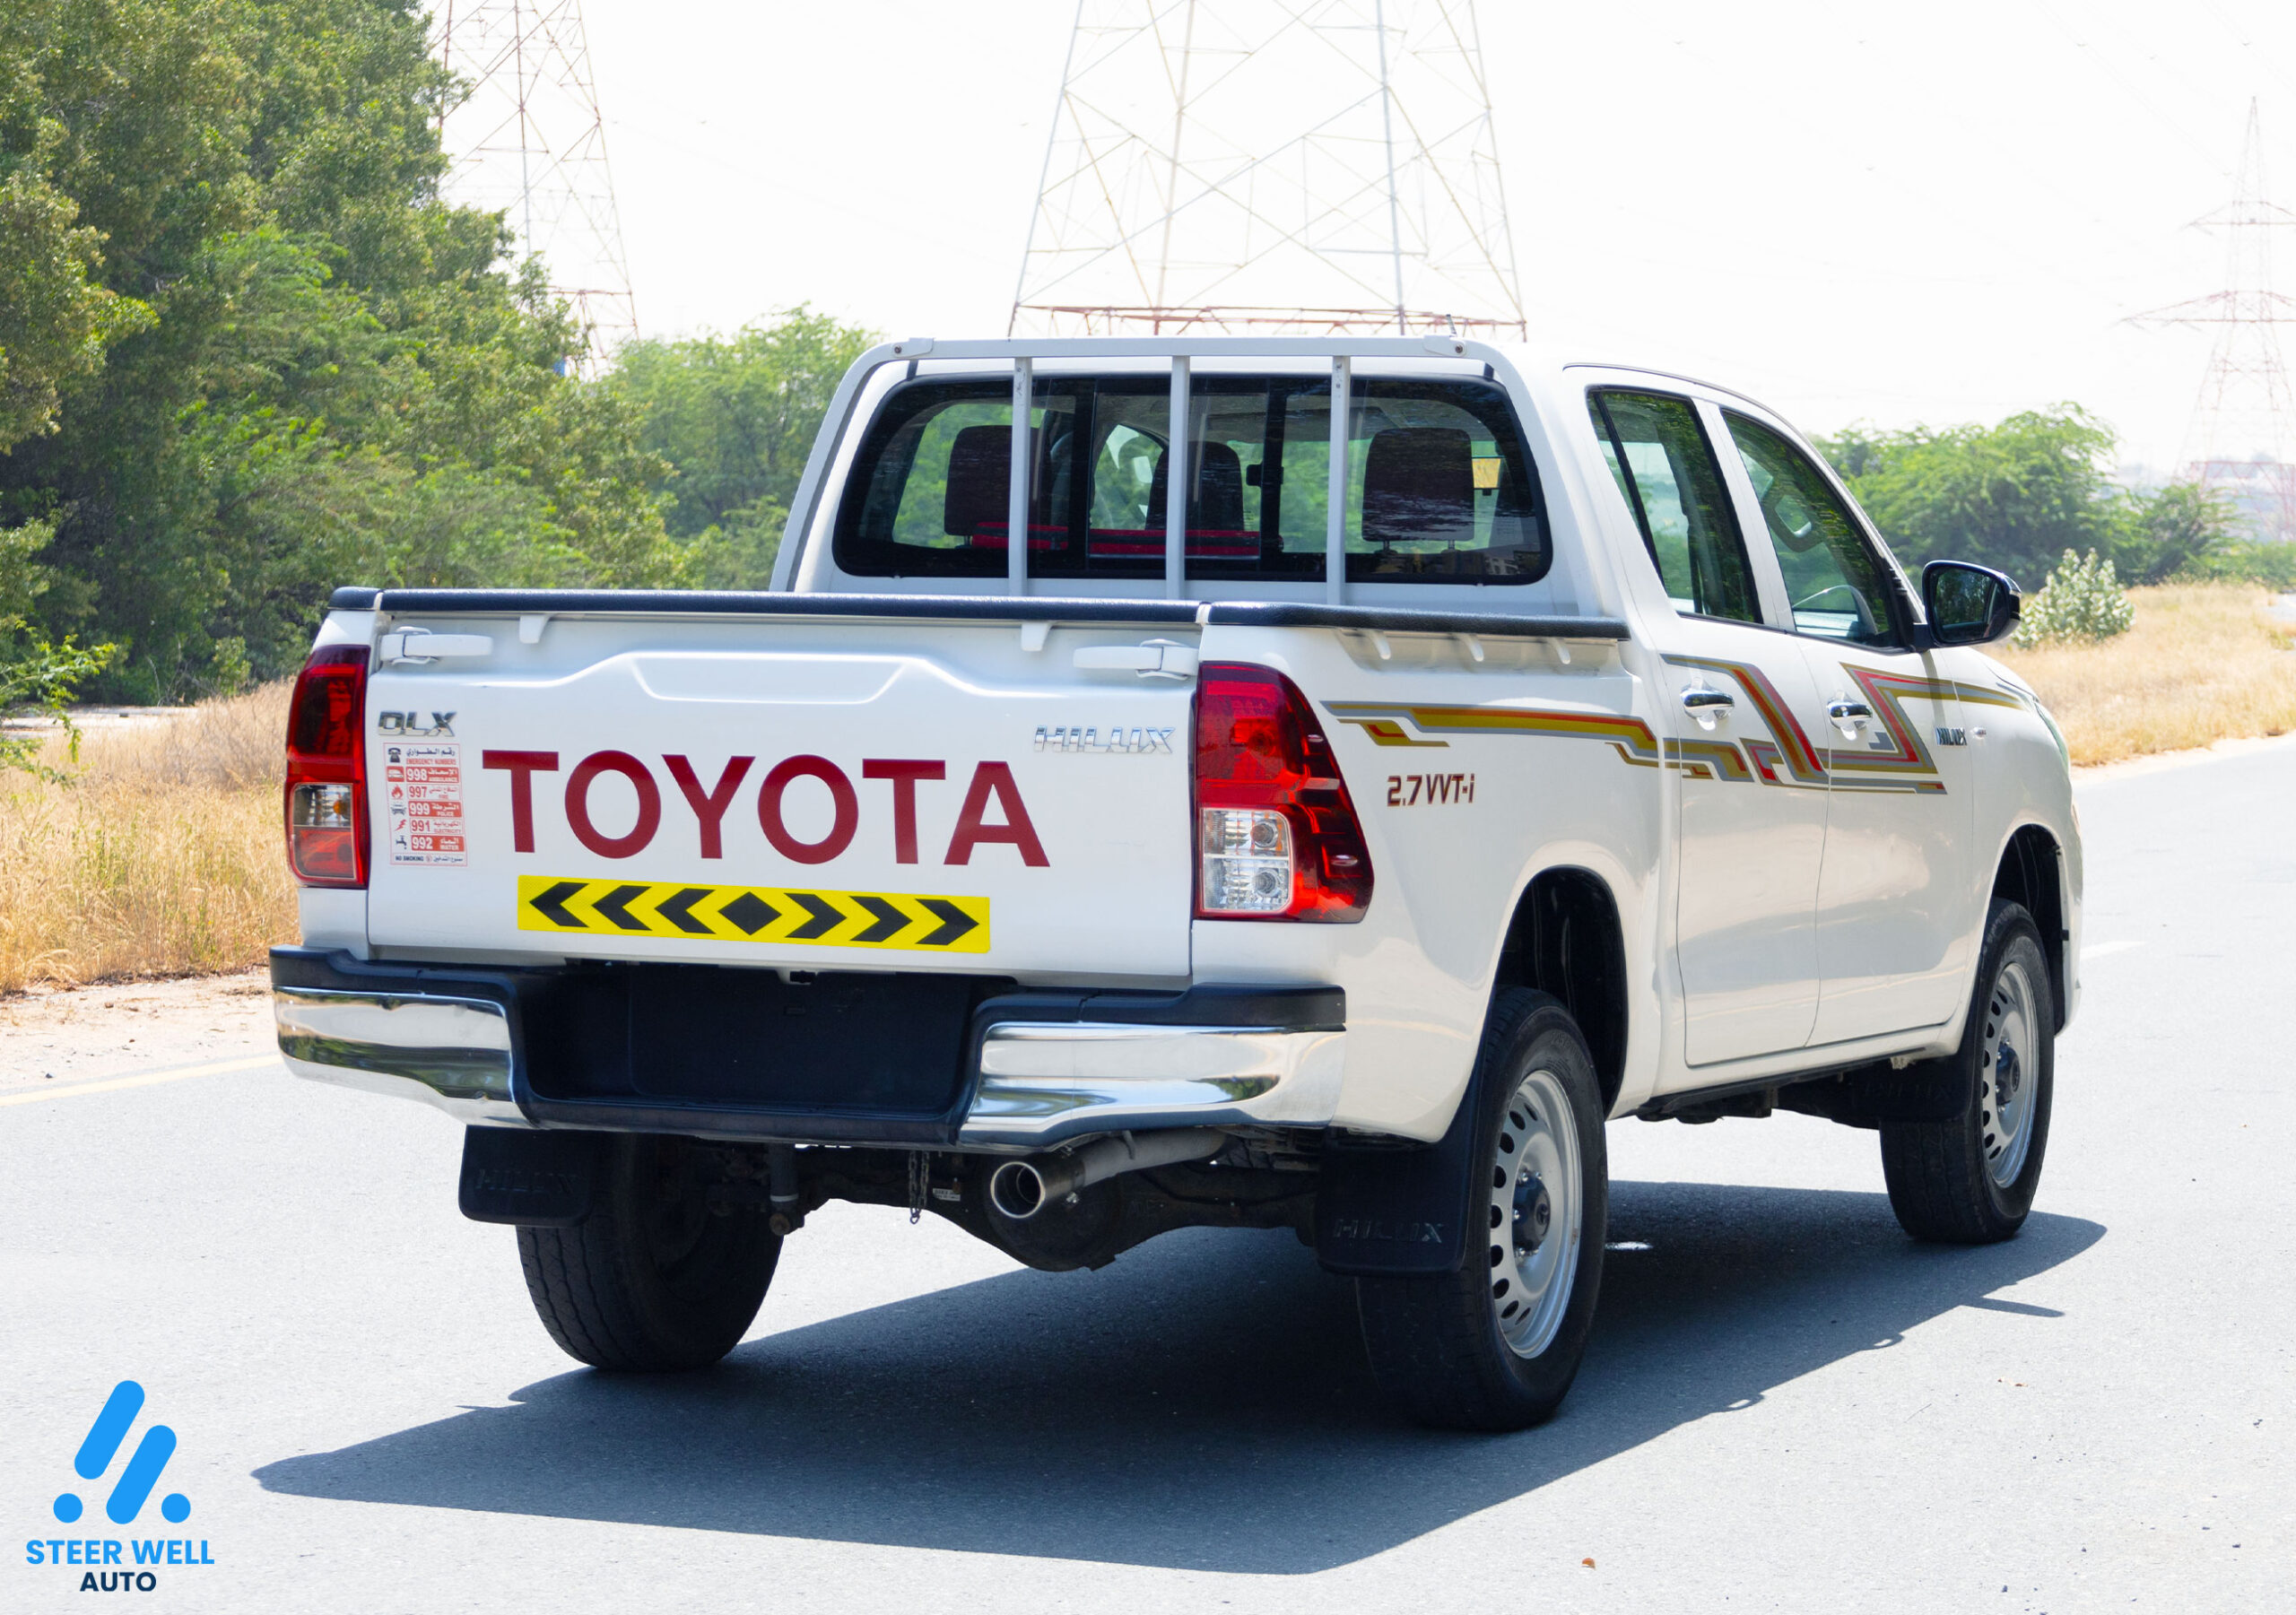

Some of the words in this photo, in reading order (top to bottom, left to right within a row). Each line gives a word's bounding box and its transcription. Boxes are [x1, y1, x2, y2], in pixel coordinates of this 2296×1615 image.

[378, 710, 457, 736] DLX
[1033, 725, 1176, 754] HILUX
[407, 768, 428, 781] 998
[409, 786, 428, 797] 997
[409, 803, 430, 815] 999
[482, 750, 1050, 867] TOYOTA
[411, 820, 430, 832] 991
[413, 837, 433, 849] 992
